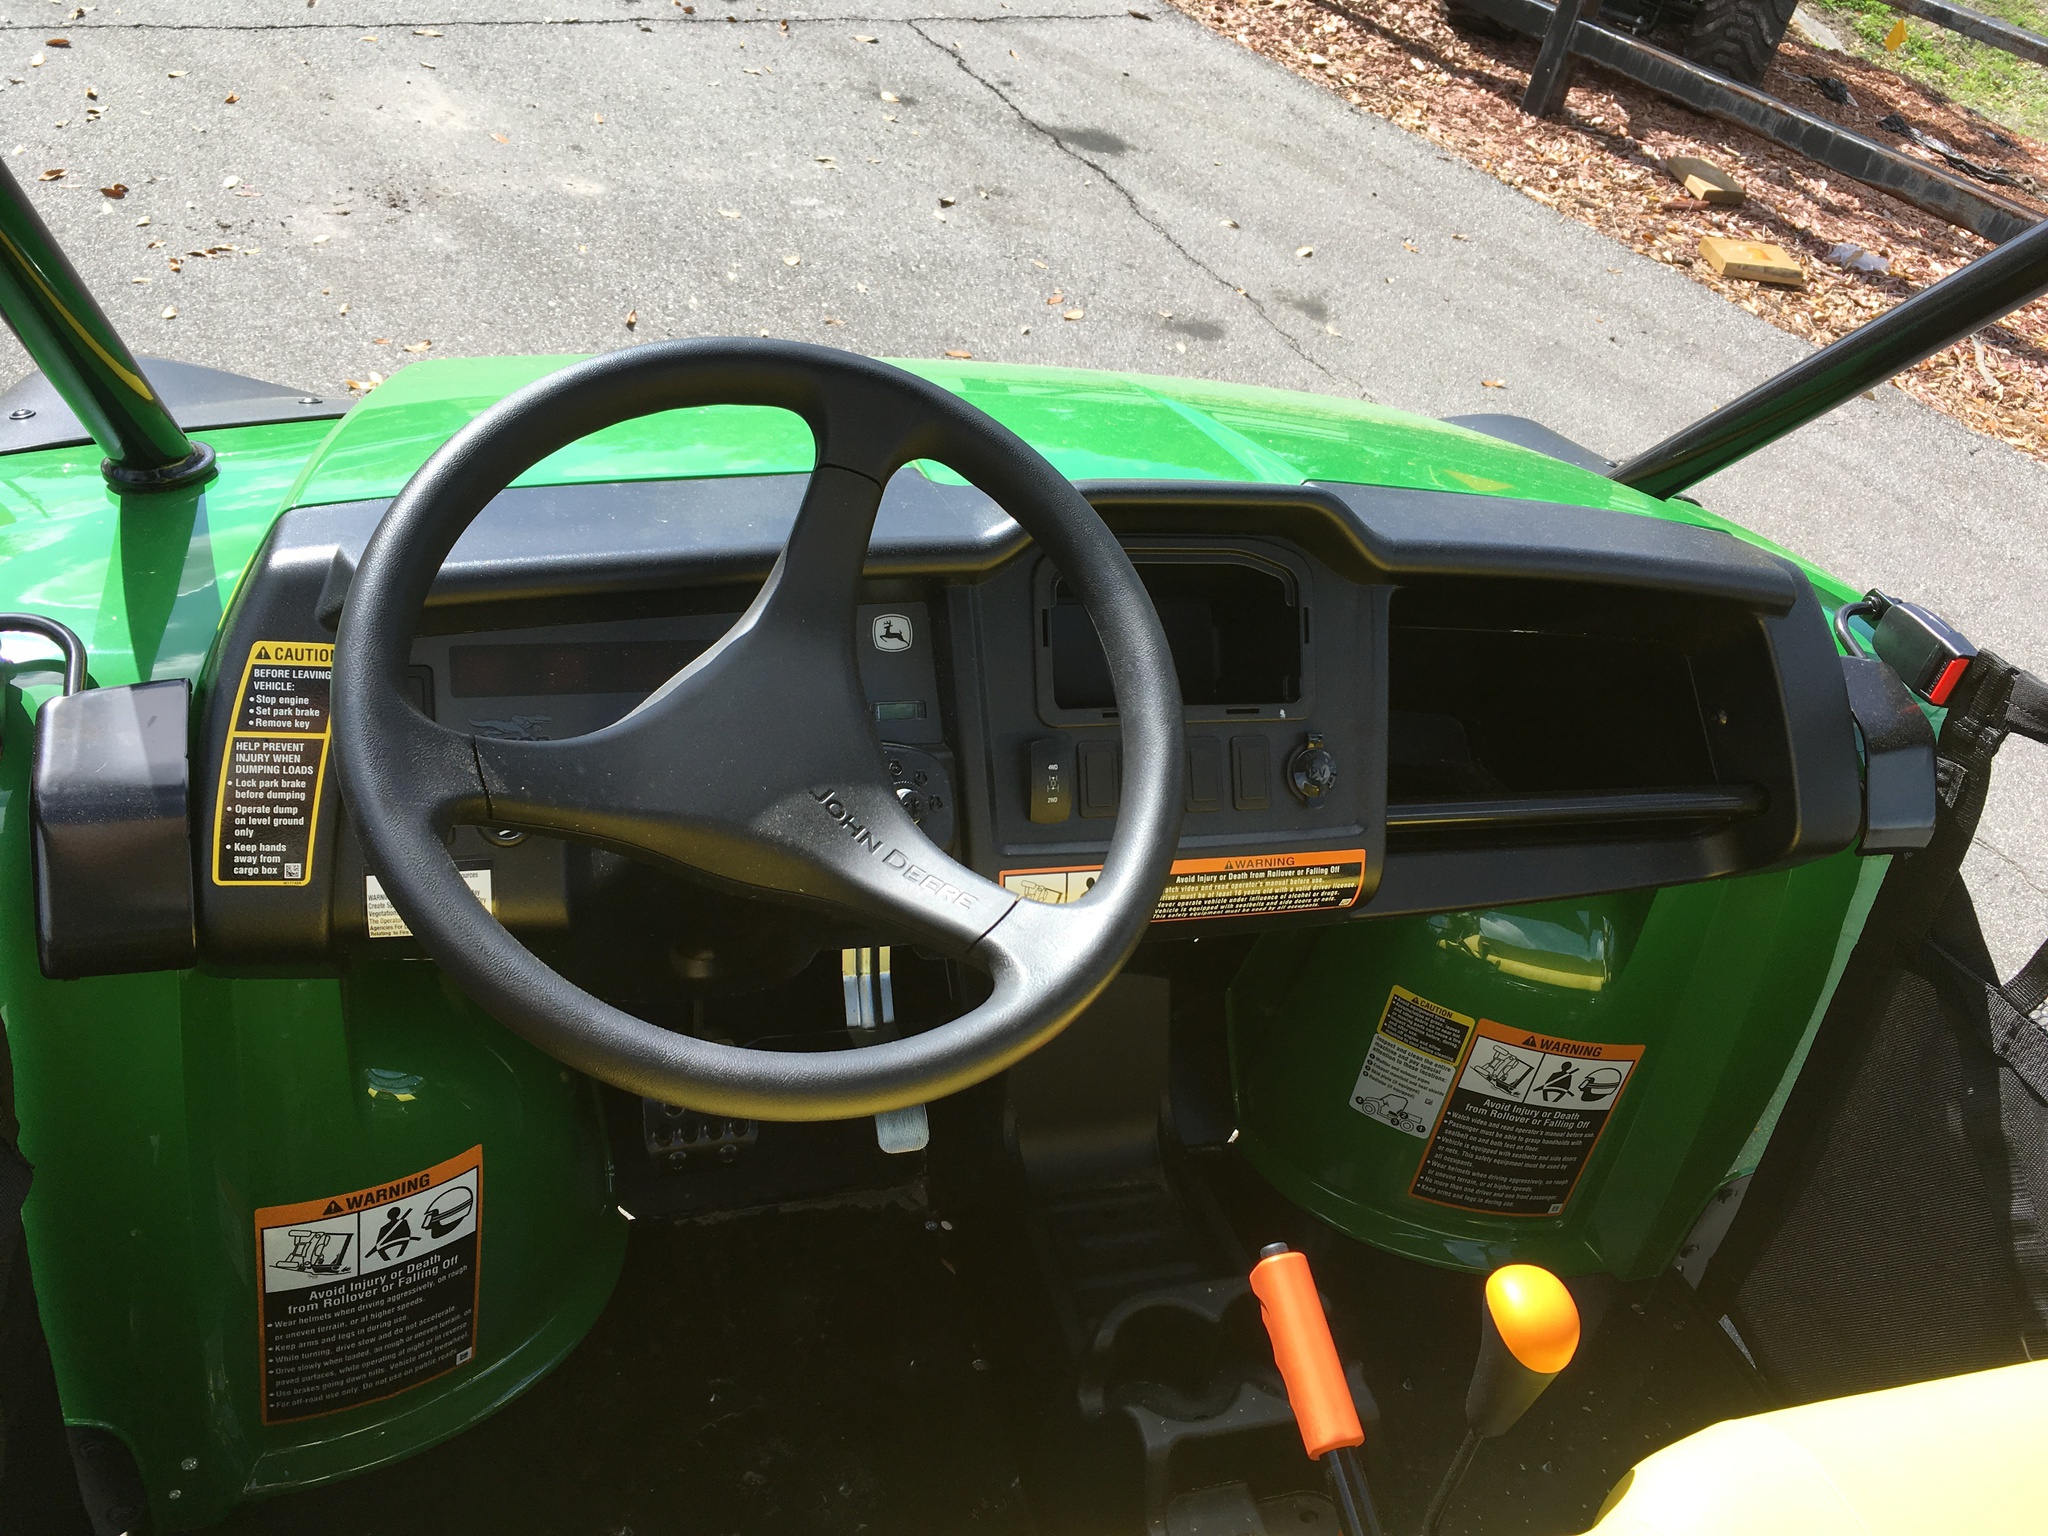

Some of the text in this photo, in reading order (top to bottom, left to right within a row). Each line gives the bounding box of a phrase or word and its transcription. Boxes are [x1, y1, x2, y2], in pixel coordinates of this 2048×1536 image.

[274, 647, 334, 662] CAUTIO
[254, 668, 332, 680] BEFORE LEAVING
[254, 681, 295, 691] VEHICLE:
[256, 695, 310, 706] Stop engine
[256, 706, 320, 718] Set park brake
[256, 718, 310, 730] Remove key
[236, 742, 305, 752] HELP PREVENT
[236, 753, 301, 763] INJURY WHEN
[235, 765, 314, 775] DUMPING LOADS
[235, 779, 306, 790] Lock park brake
[235, 790, 306, 801] before dumping
[235, 804, 299, 816] Operate dump
[234, 816, 305, 827] on level ground
[234, 828, 254, 838] only
[234, 842, 287, 854] Keep hands
[808, 788, 979, 910] JOHN DEERE
[233, 854, 281, 864] away from
[1235, 856, 1295, 869] WARNING
[233, 865, 278, 876] cargo box
[1176, 875, 1196, 884] Avoid
[1197, 874, 1217, 883] Injury
[1228, 872, 1248, 881] Death
[1250, 871, 1265, 879] from
[1266, 869, 1295, 878] Rollover
[1305, 866, 1329, 876] Falling
[1330, 865, 1340, 873] Off
[1163, 886, 1179, 894] atch
[1230, 880, 1263, 890] operator's
[1419, 1000, 1453, 1019] CAUTION
[1540, 1038, 1602, 1057] WARNING
[1483, 1099, 1580, 1120] Avoid Injury or Death
[1465, 1103, 1591, 1130] from Rollover or Falling Off
[346, 1173, 430, 1210] WARNING
[309, 1254, 441, 1301] Avoid Injury or Death
[288, 1255, 459, 1314] from Rollover or Falling Off
[274, 1265, 468, 1328] Wear helmets when driving aggressively, on rough
